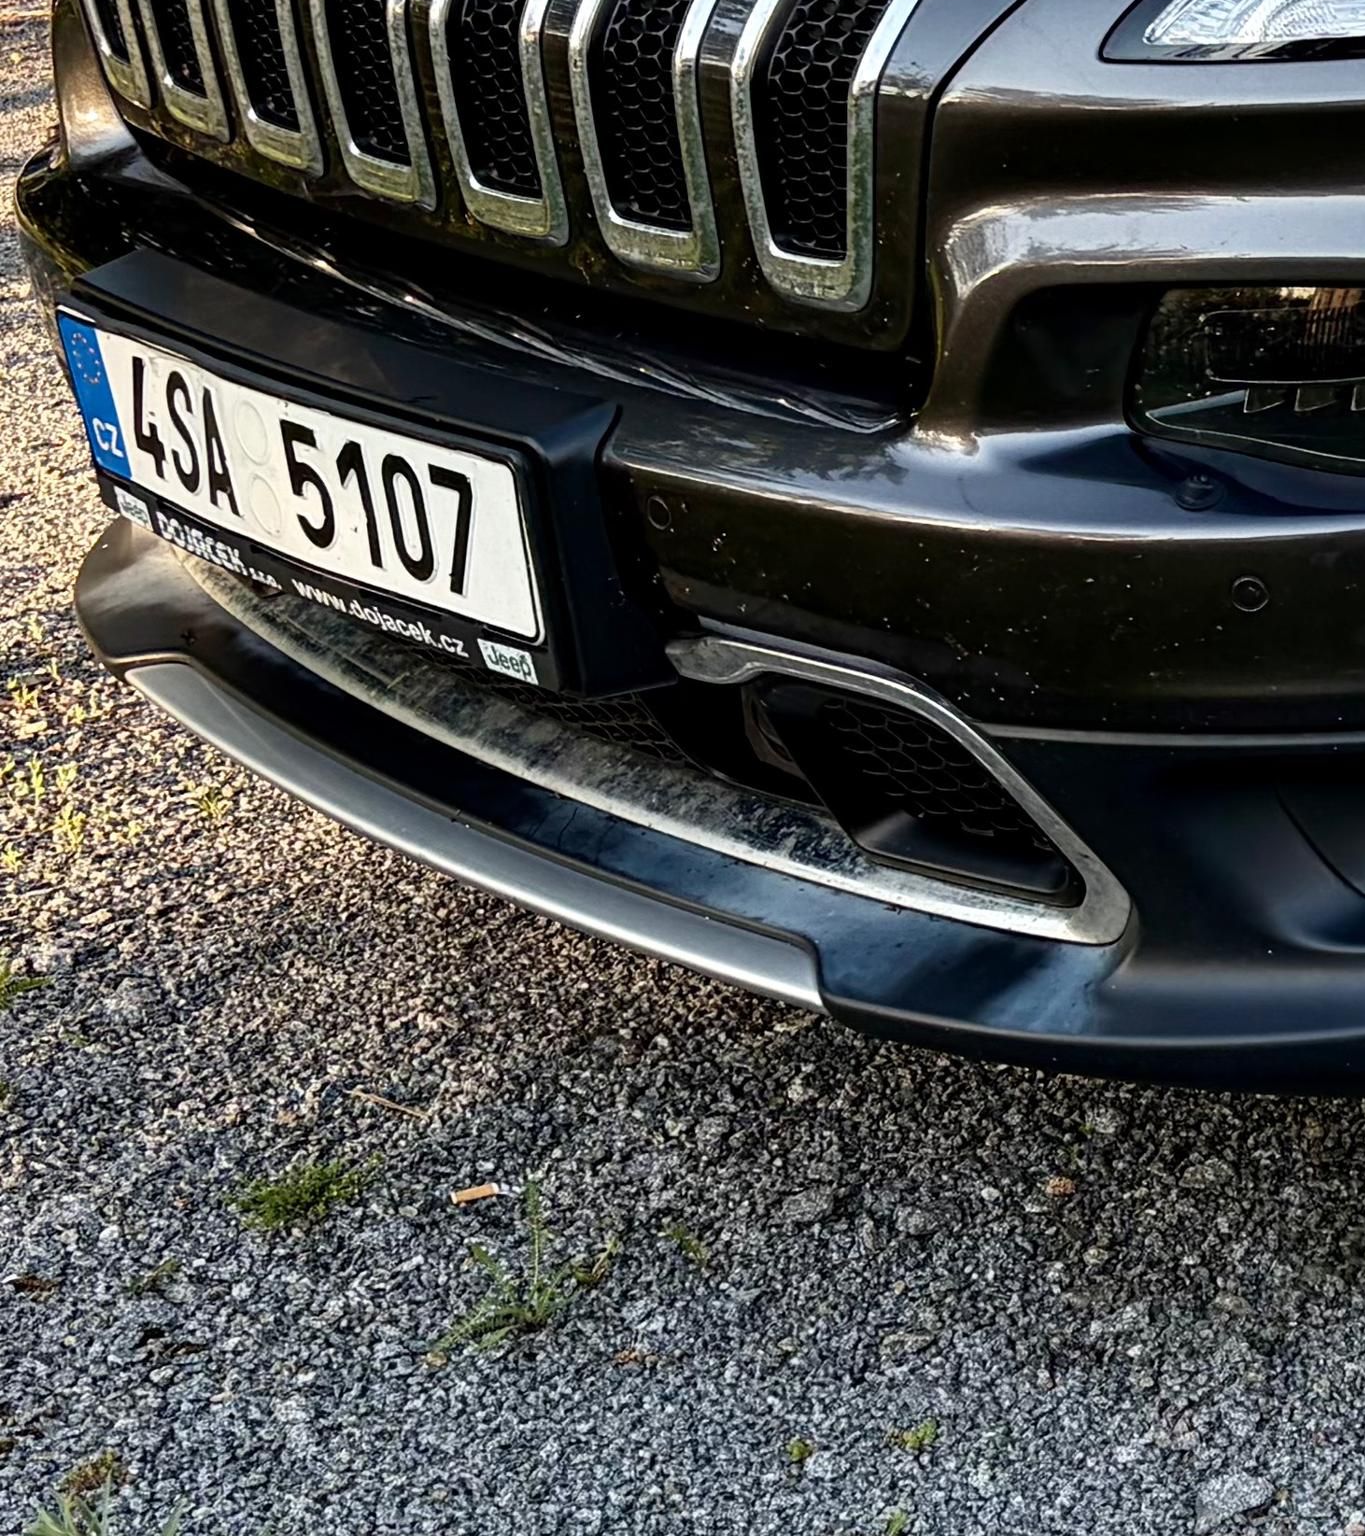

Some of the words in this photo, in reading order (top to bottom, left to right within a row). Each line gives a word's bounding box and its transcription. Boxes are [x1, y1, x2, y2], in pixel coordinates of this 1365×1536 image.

[92, 417, 125, 458] CZ
[132, 355, 242, 518] 4SA
[280, 419, 475, 596] 5107
[291, 577, 470, 659] www.dojacek.cz
[486, 645, 532, 678] Jeep
